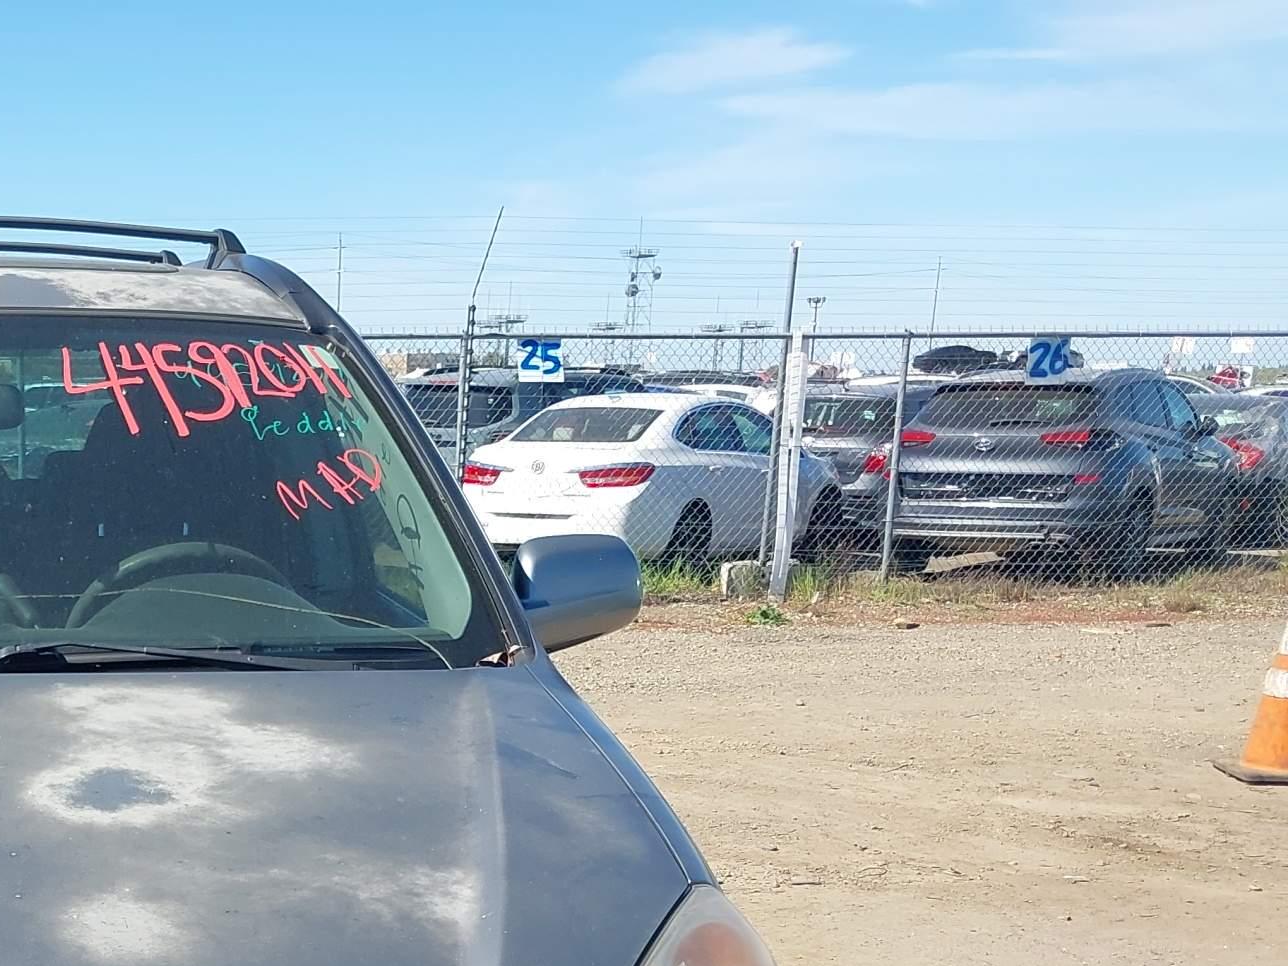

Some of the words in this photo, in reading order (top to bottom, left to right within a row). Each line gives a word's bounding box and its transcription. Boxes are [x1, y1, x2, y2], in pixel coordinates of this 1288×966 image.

[520, 339, 562, 375] 25
[1029, 337, 1071, 378] 26
[62, 341, 353, 437] 44592011
